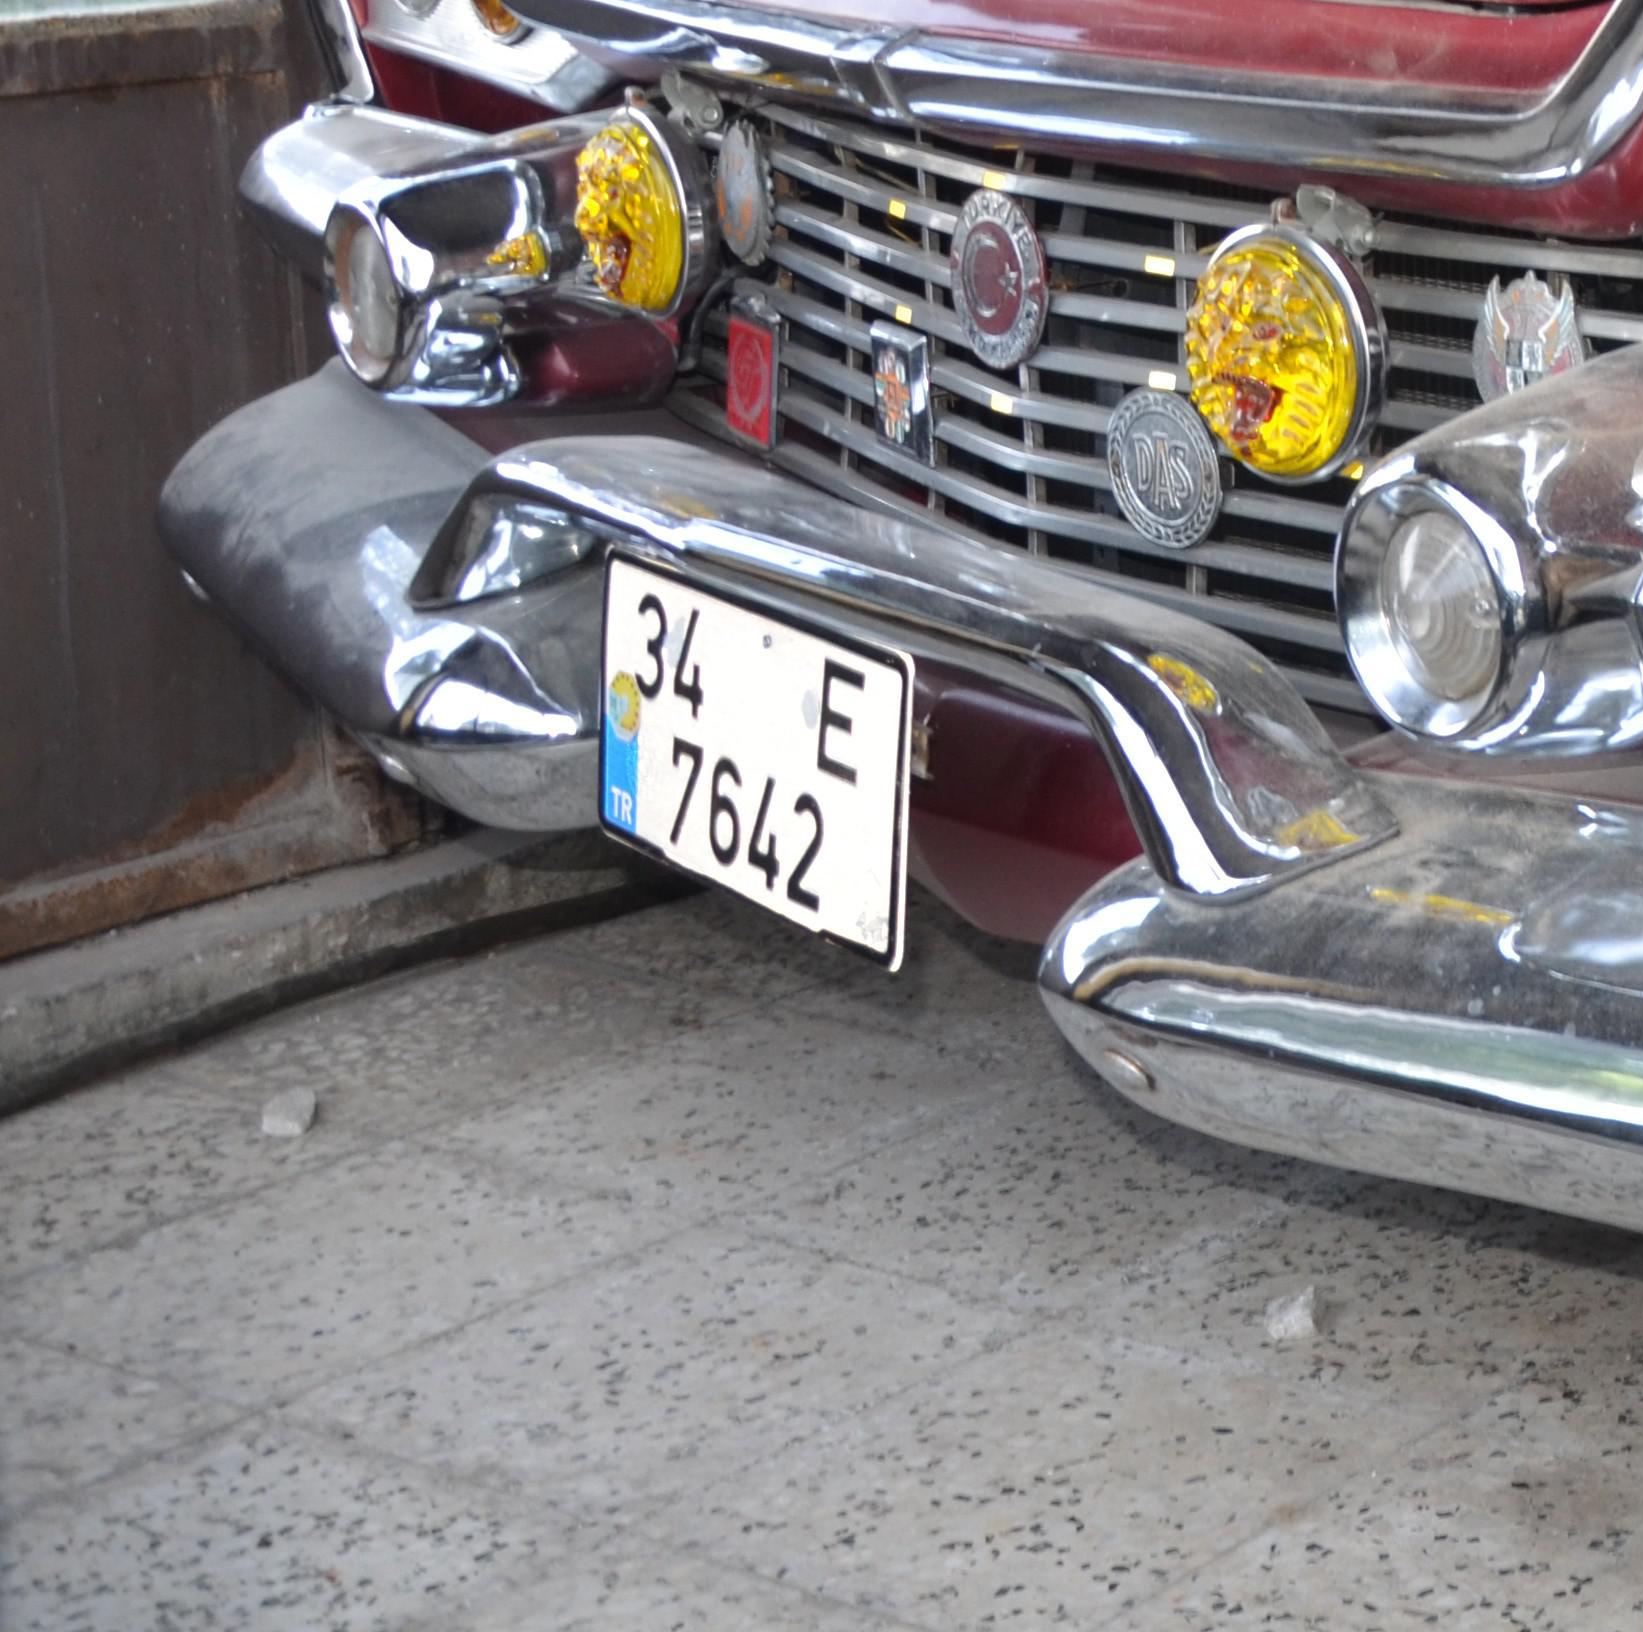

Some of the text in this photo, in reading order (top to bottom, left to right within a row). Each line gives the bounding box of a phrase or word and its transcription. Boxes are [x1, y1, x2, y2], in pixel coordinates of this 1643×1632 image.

[1132, 431, 1195, 511] DAS
[635, 593, 866, 785] 34 E
[610, 786, 634, 825] TR
[669, 737, 825, 913] 7642
